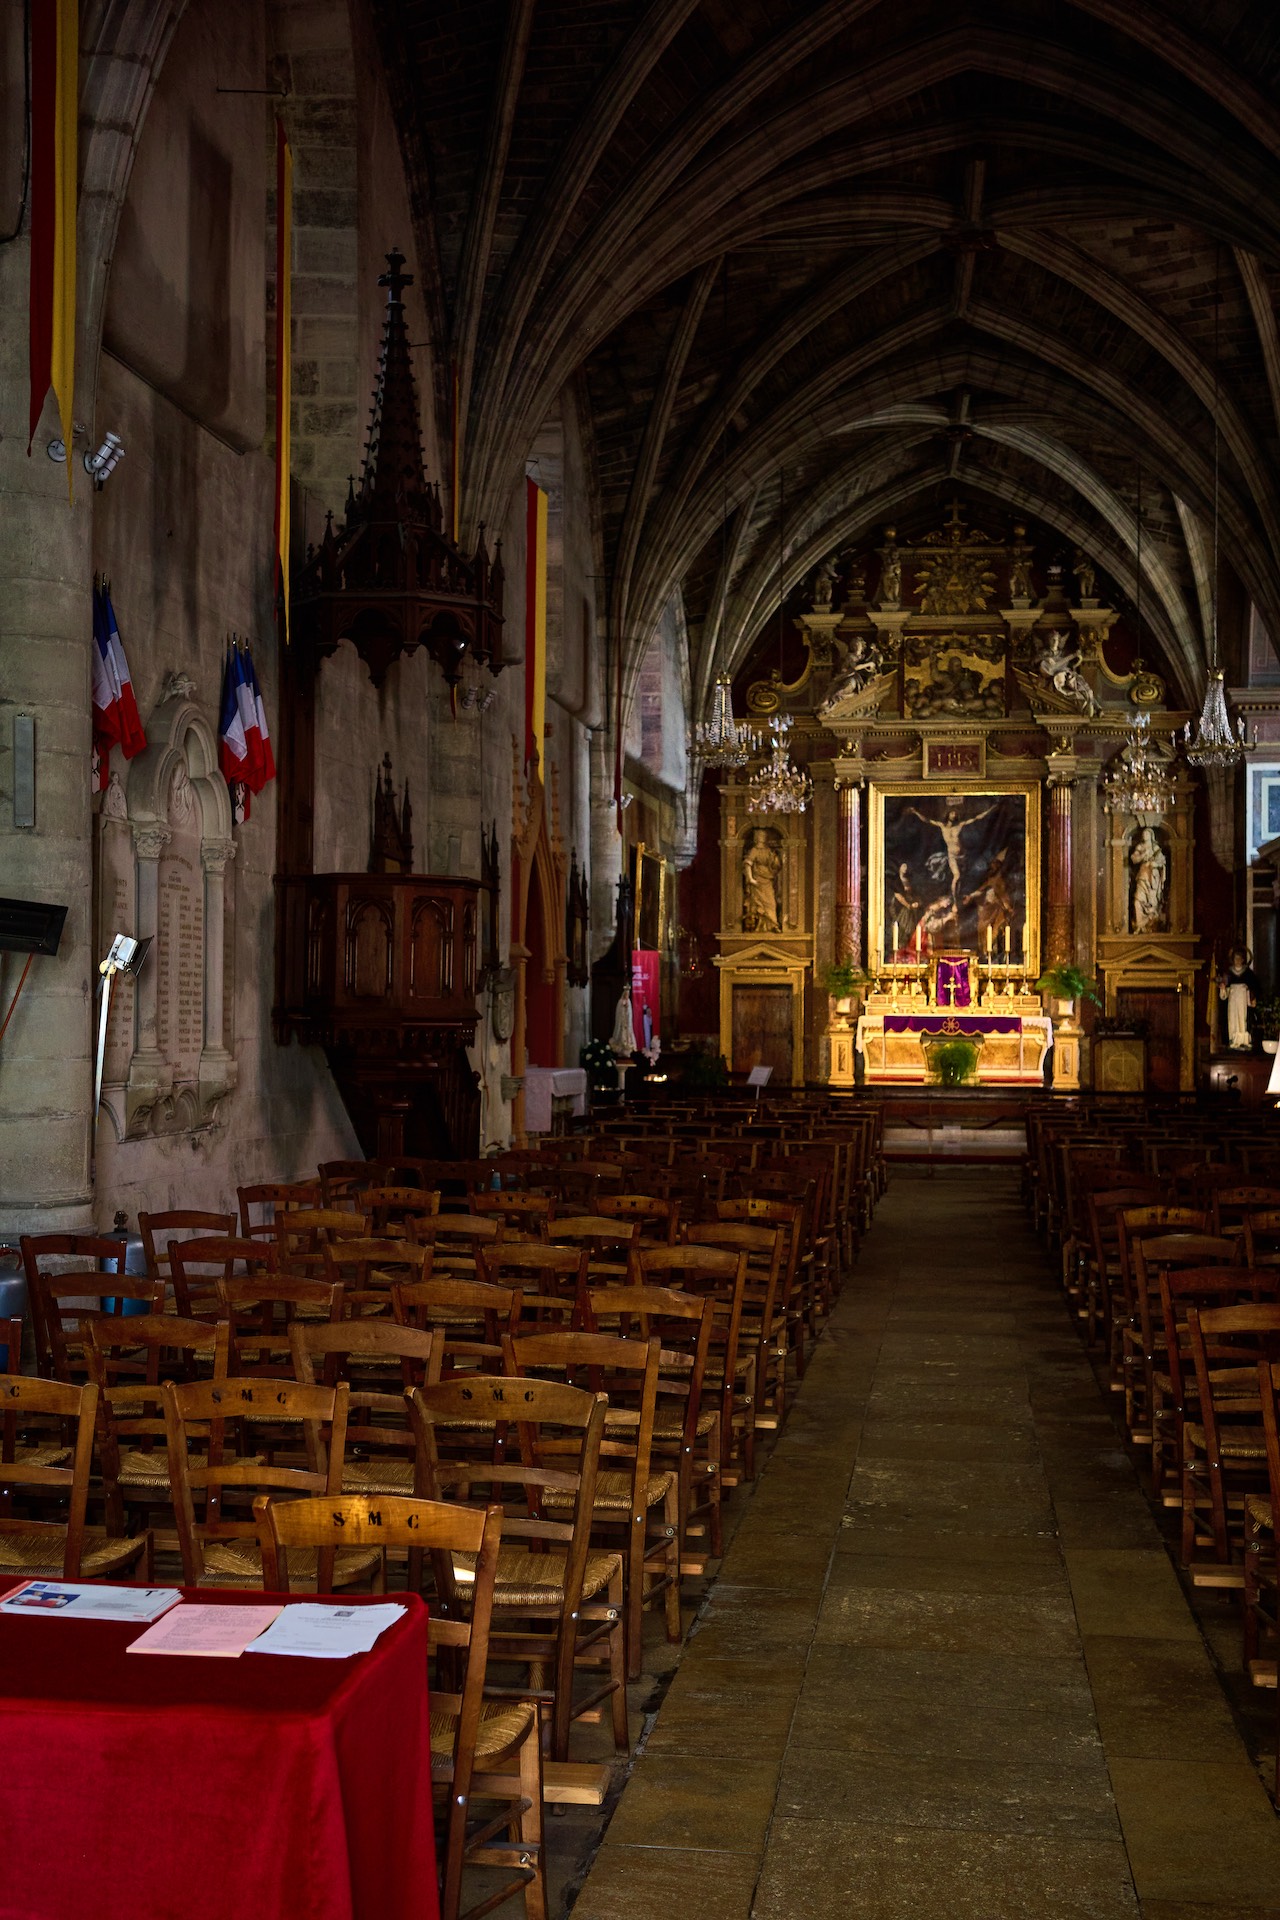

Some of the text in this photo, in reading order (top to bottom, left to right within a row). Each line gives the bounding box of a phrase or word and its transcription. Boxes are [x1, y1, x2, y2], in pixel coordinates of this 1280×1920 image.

[9, 1385, 20, 1398] C
[333, 1511, 419, 1529] S M C
